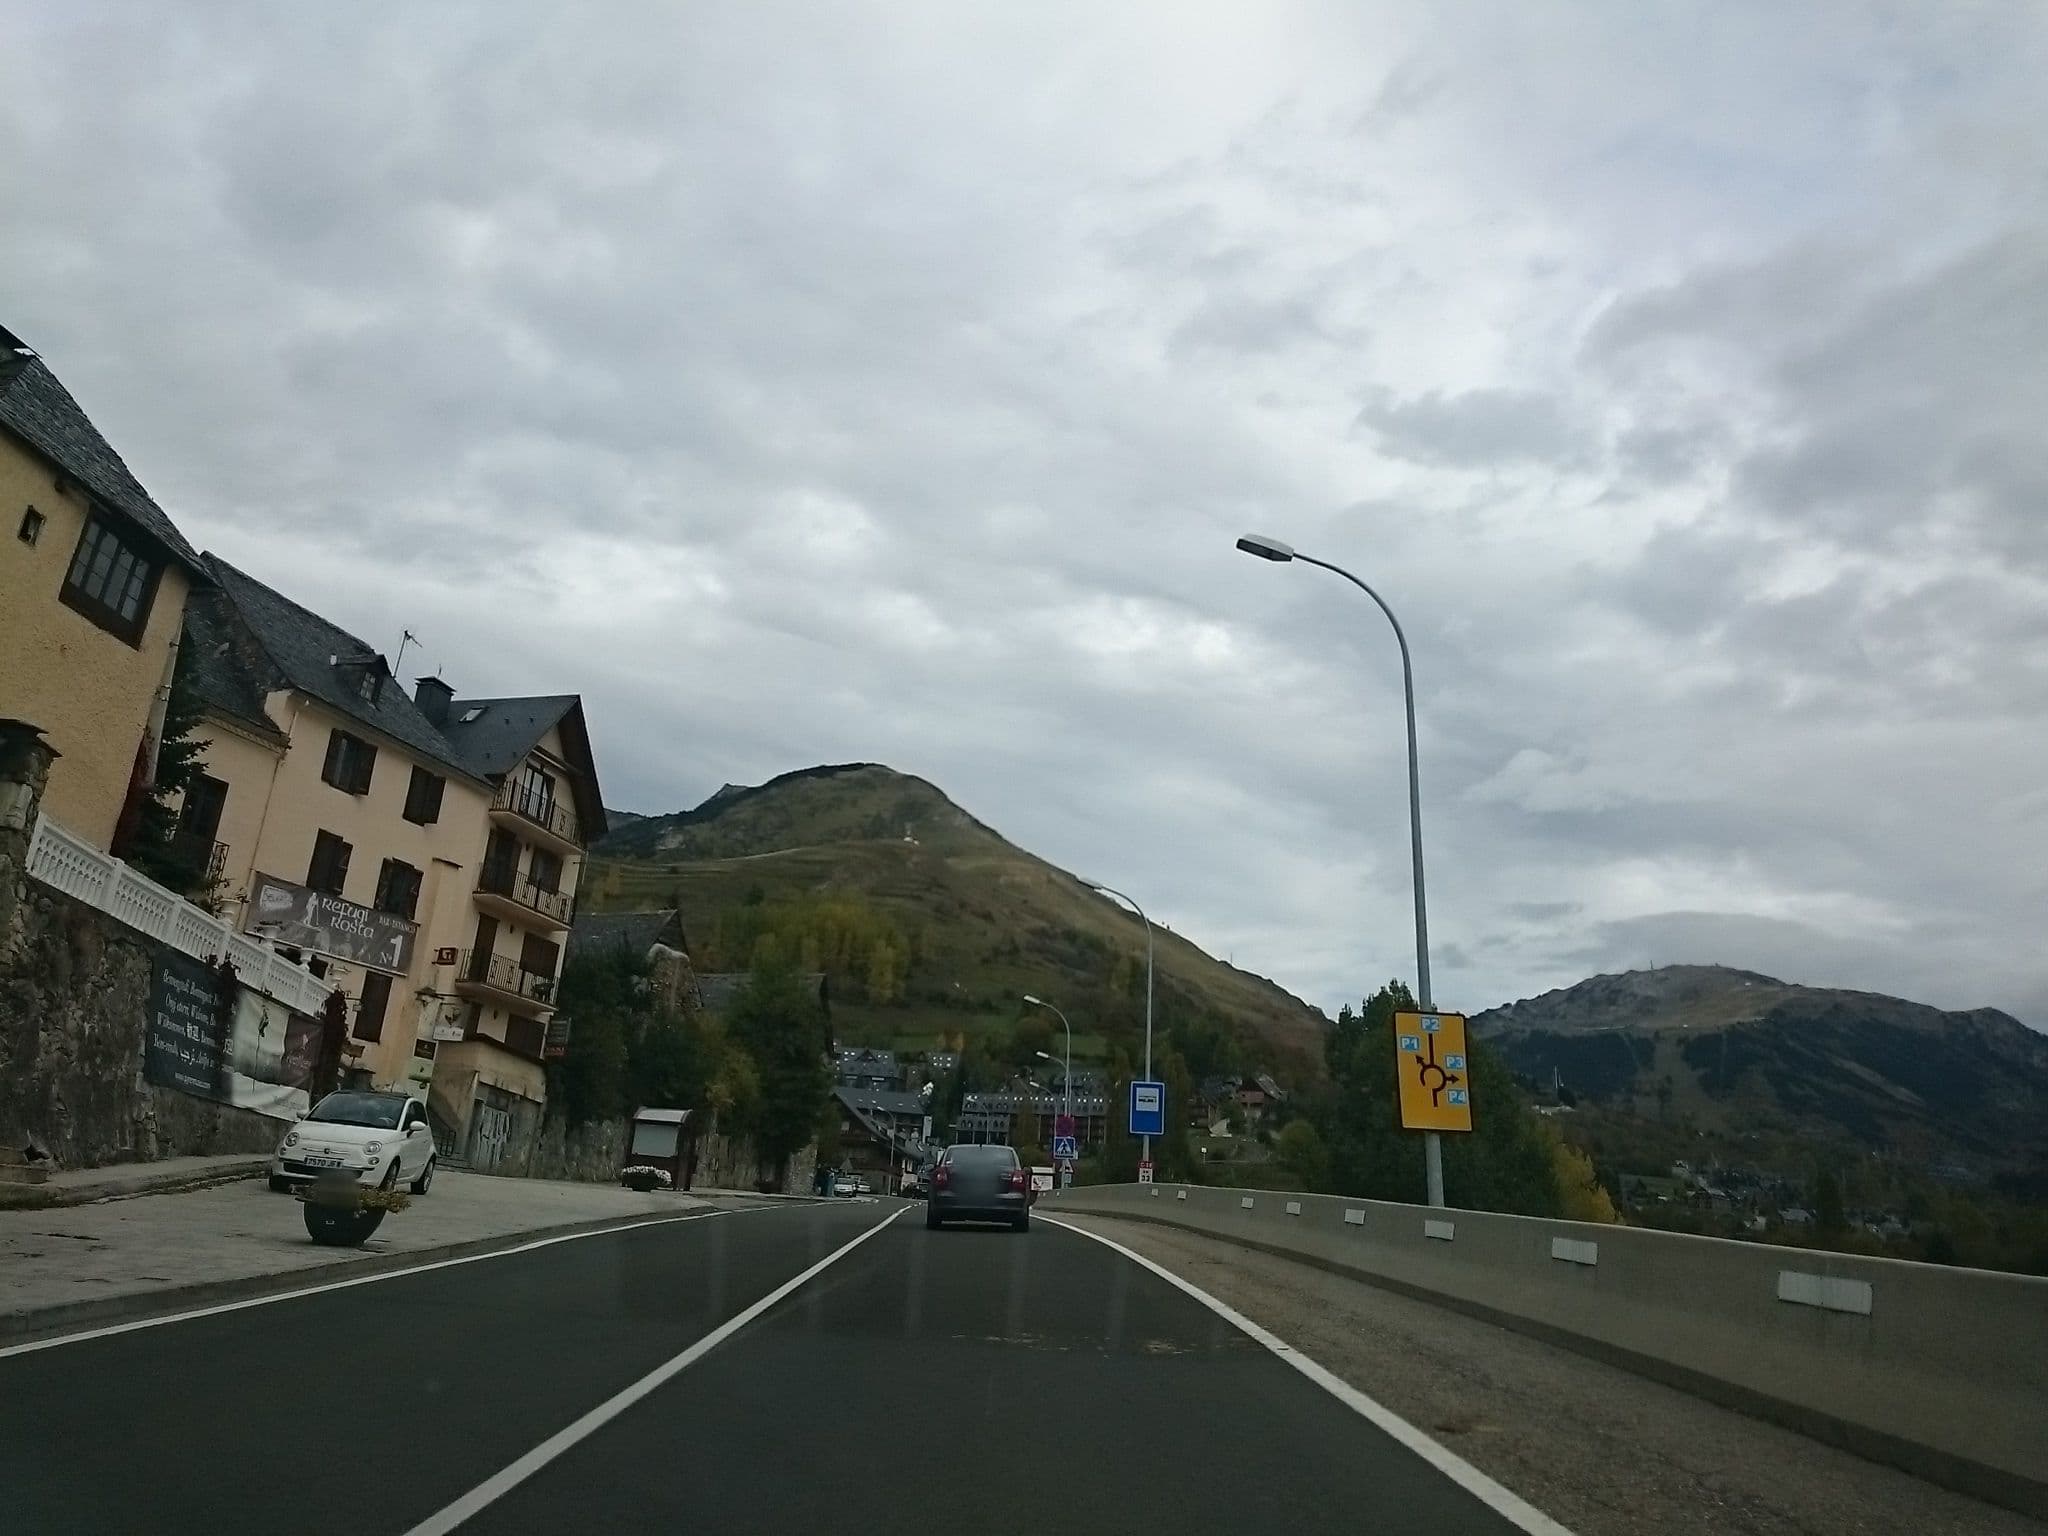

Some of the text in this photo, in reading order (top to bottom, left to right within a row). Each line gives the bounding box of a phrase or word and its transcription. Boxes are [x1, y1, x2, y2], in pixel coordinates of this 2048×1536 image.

[322, 897, 369, 923] Refugi
[330, 915, 375, 939] Rosta
[1422, 1017, 1439, 1031] P2
[1401, 1037, 1418, 1050] P1
